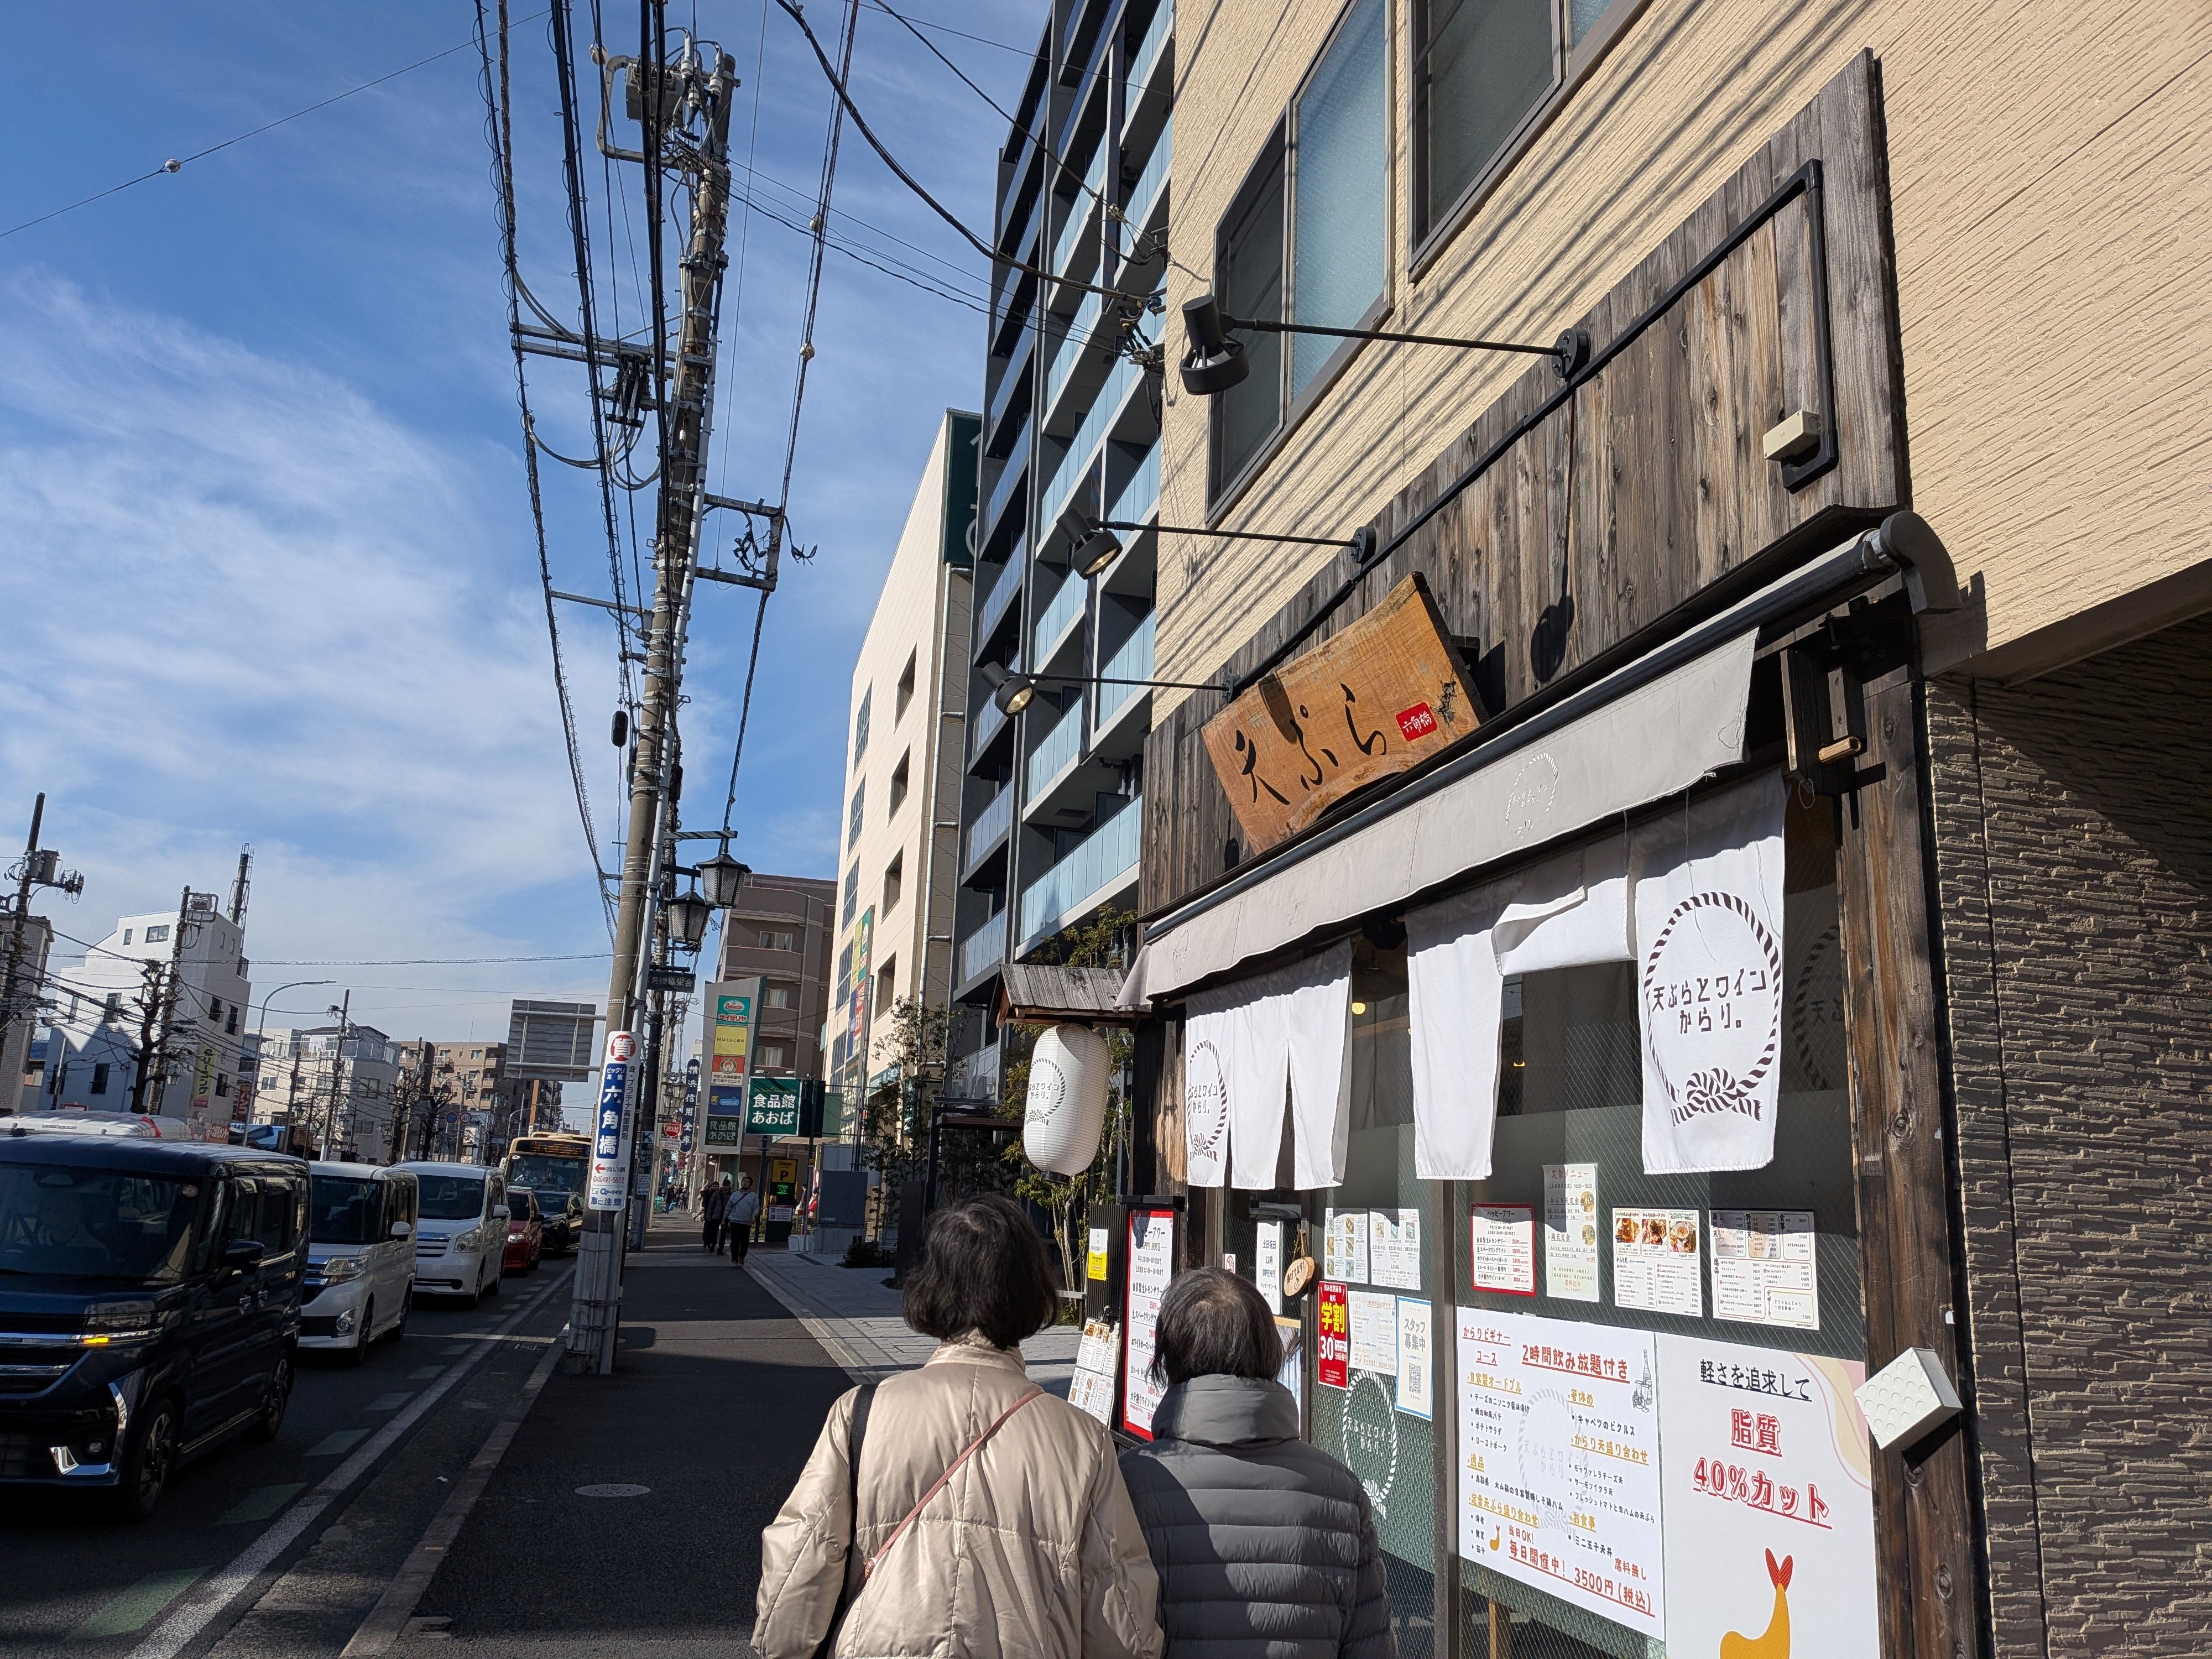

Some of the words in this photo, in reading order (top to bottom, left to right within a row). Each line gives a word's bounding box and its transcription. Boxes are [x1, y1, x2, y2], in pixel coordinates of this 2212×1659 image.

[1401, 710, 1432, 733] 六角橋
[1512, 784, 1547, 804] 天ぷらとイン
[649, 977, 692, 987] 角橋協栄会
[1652, 968, 1767, 1013] 天ぷらとワイン
[1679, 1003, 1741, 1035] からり。
[613, 1038, 633, 1057] 質
[681, 1065, 698, 1146] 横浜信用金庫
[753, 1093, 796, 1108] 食品館
[598, 1085, 623, 1155] 六角橋
[709, 1121, 736, 1130] 食品館
[752, 1111, 795, 1125] あおば
[708, 1132, 735, 1141] あおば
[1552, 1170, 1589, 1179] 定食メニュー
[591, 1197, 622, 1206] 車に注意
[1132, 1308, 1156, 1324] 生スパークリングワ
[1322, 1301, 1345, 1333] 学割
[1405, 1318, 1426, 1333] スタッフ
[1404, 1333, 1426, 1352] 募集中
[1463, 1326, 1510, 1342] からりビギナー
[1321, 1335, 1333, 1360] 30
[1477, 1350, 1497, 1363] コース
[1522, 1344, 1628, 1379] 2時間飲み放題付き
[1470, 1371, 1521, 1392] 自家製オードブル
[1700, 1359, 1811, 1400] 軽さを追求して
[1475, 1394, 1529, 1413] チーズのニンニク醤油漬け
[1571, 1389, 1593, 1405] 箸休め
[1476, 1421, 1502, 1436] ポテトサラダ
[1578, 1415, 1635, 1436] キャベツのピクルス
[1731, 1408, 1781, 1453] 脂質
[1477, 1437, 1507, 1452] ローストポーク
[1575, 1434, 1647, 1463] からり天盛り合わせ
[1470, 1453, 1484, 1468] 逸品
[1476, 1474, 1489, 1486] 鳥取県
[1575, 1479, 1613, 1496] サーモンイクラ天
[1694, 1457, 1829, 1522] 40%カット
[1471, 1493, 1538, 1526] 定番天ぷら盛り合わせ
[1575, 1493, 1655, 1524] フレッシュトマトと生ハムの天ぷら
[1573, 1512, 1595, 1529] お食事
[1509, 1525, 1533, 1545] 当日OK!
[1575, 1536, 1612, 1557] ミニ玉子天丼
[1509, 1540, 1566, 1577] 毎日開催中!
[1614, 1557, 1647, 1580] 席料無し
